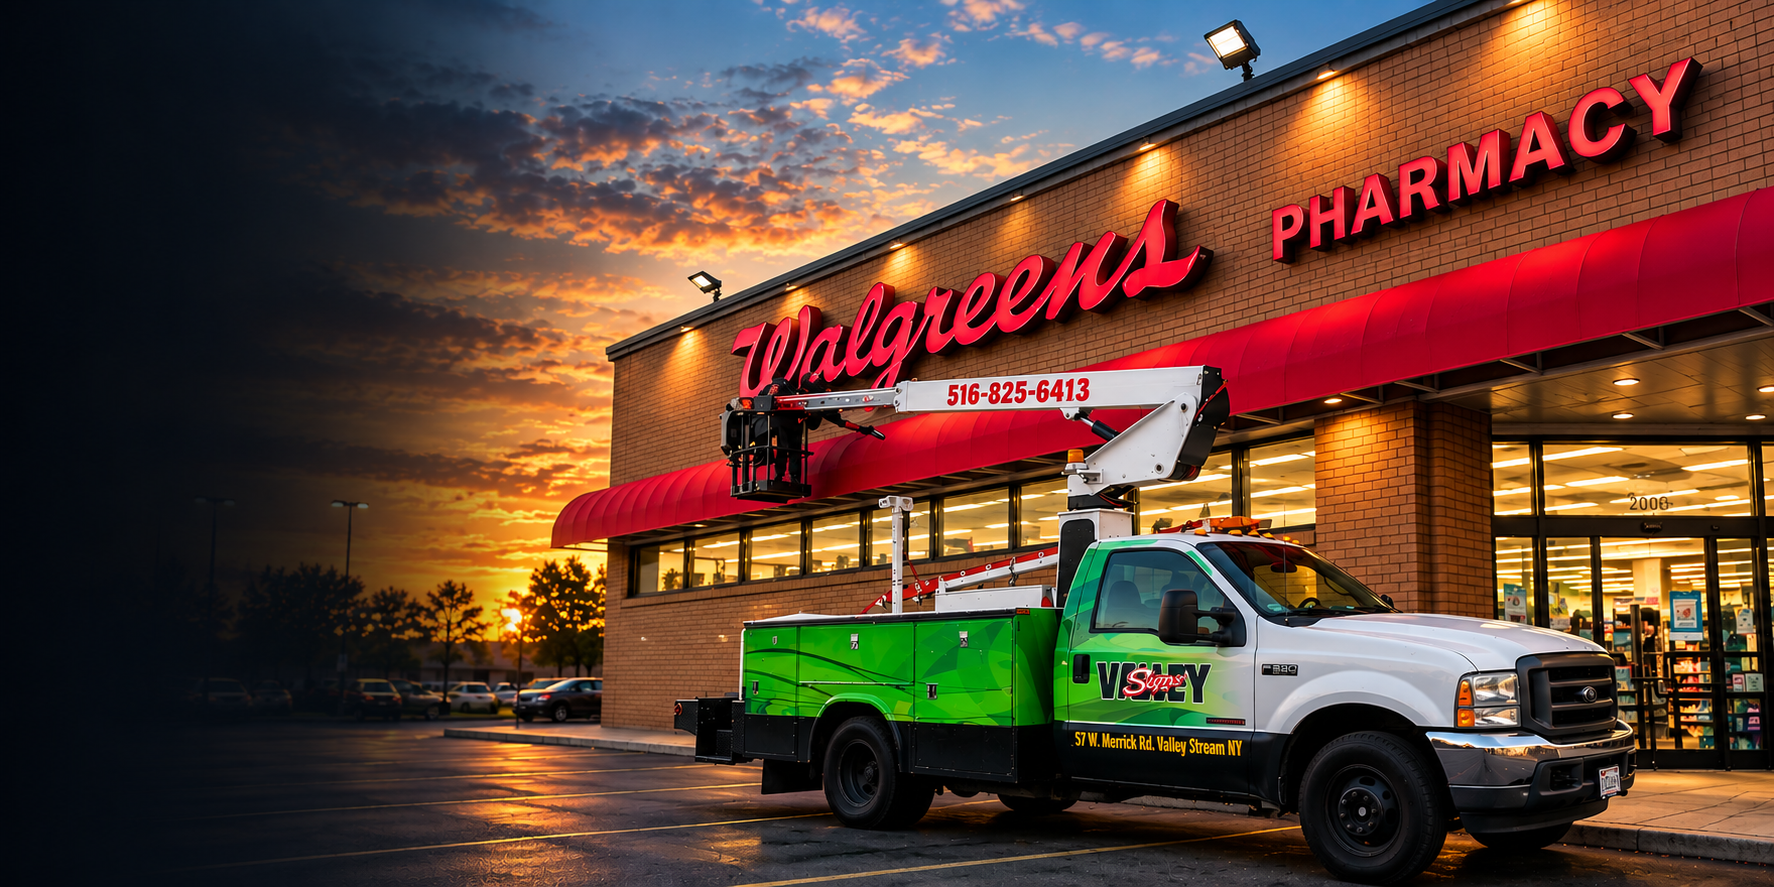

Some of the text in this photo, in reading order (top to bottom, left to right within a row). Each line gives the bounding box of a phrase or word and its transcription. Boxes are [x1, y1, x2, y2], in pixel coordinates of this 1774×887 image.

[1272, 57, 1702, 264] PHARMACY
[731, 199, 1213, 412] Walgreens
[947, 377, 1090, 406] 516-825-6413
[1122, 667, 1188, 696] Signs
[1088, 732, 1100, 747] W.
[1102, 733, 1137, 750] Merrick
[1139, 736, 1155, 751] Rd.
[1157, 737, 1186, 757] Valley
[1189, 738, 1225, 756] Stream
[1228, 740, 1243, 756] NY
